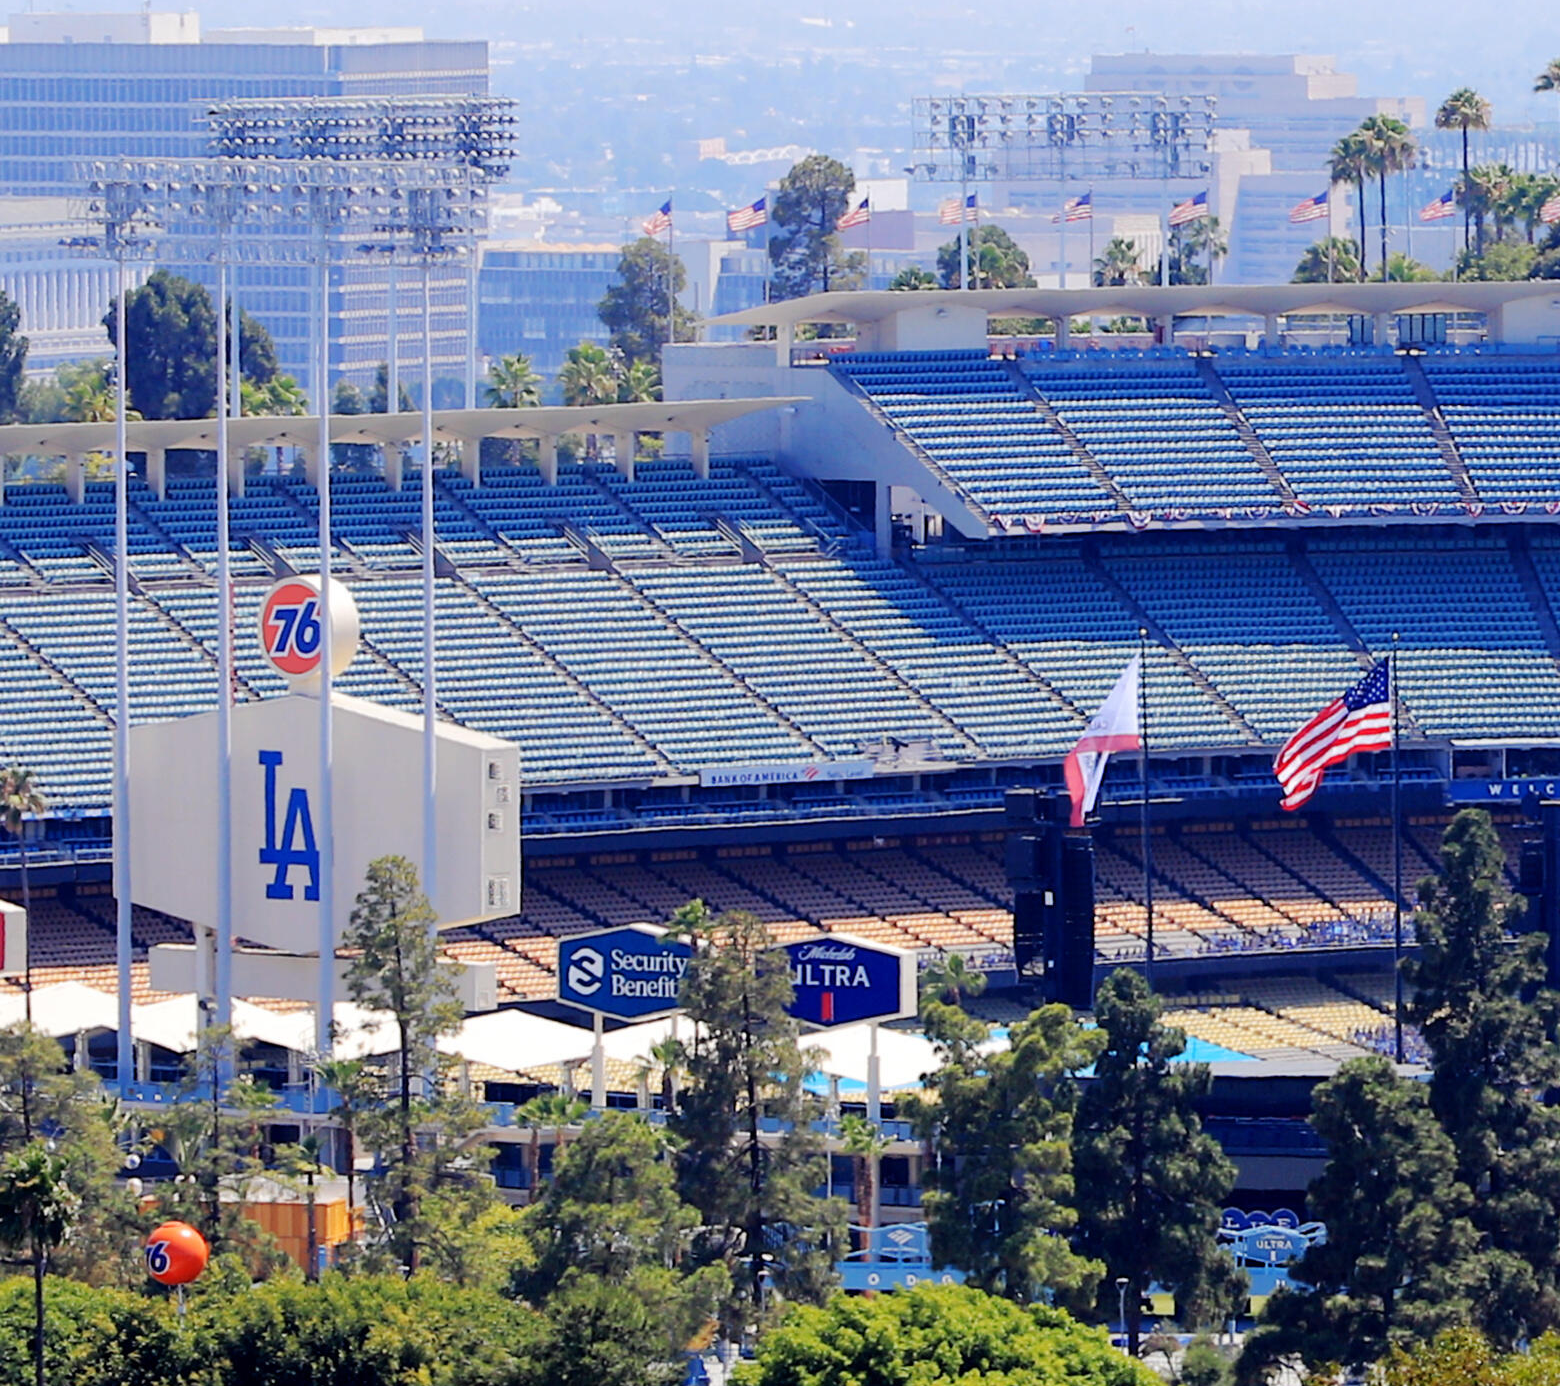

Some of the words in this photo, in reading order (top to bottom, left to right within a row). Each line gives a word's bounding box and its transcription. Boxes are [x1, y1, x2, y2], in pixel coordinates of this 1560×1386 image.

[271, 599, 320, 655] 76
[711, 775, 738, 785] BANK
[754, 771, 799, 782] AMERICA
[258, 749, 320, 902] LA
[611, 948, 689, 979] Security
[612, 973, 679, 999] Benefit
[1255, 1239, 1293, 1250] ULTRA
